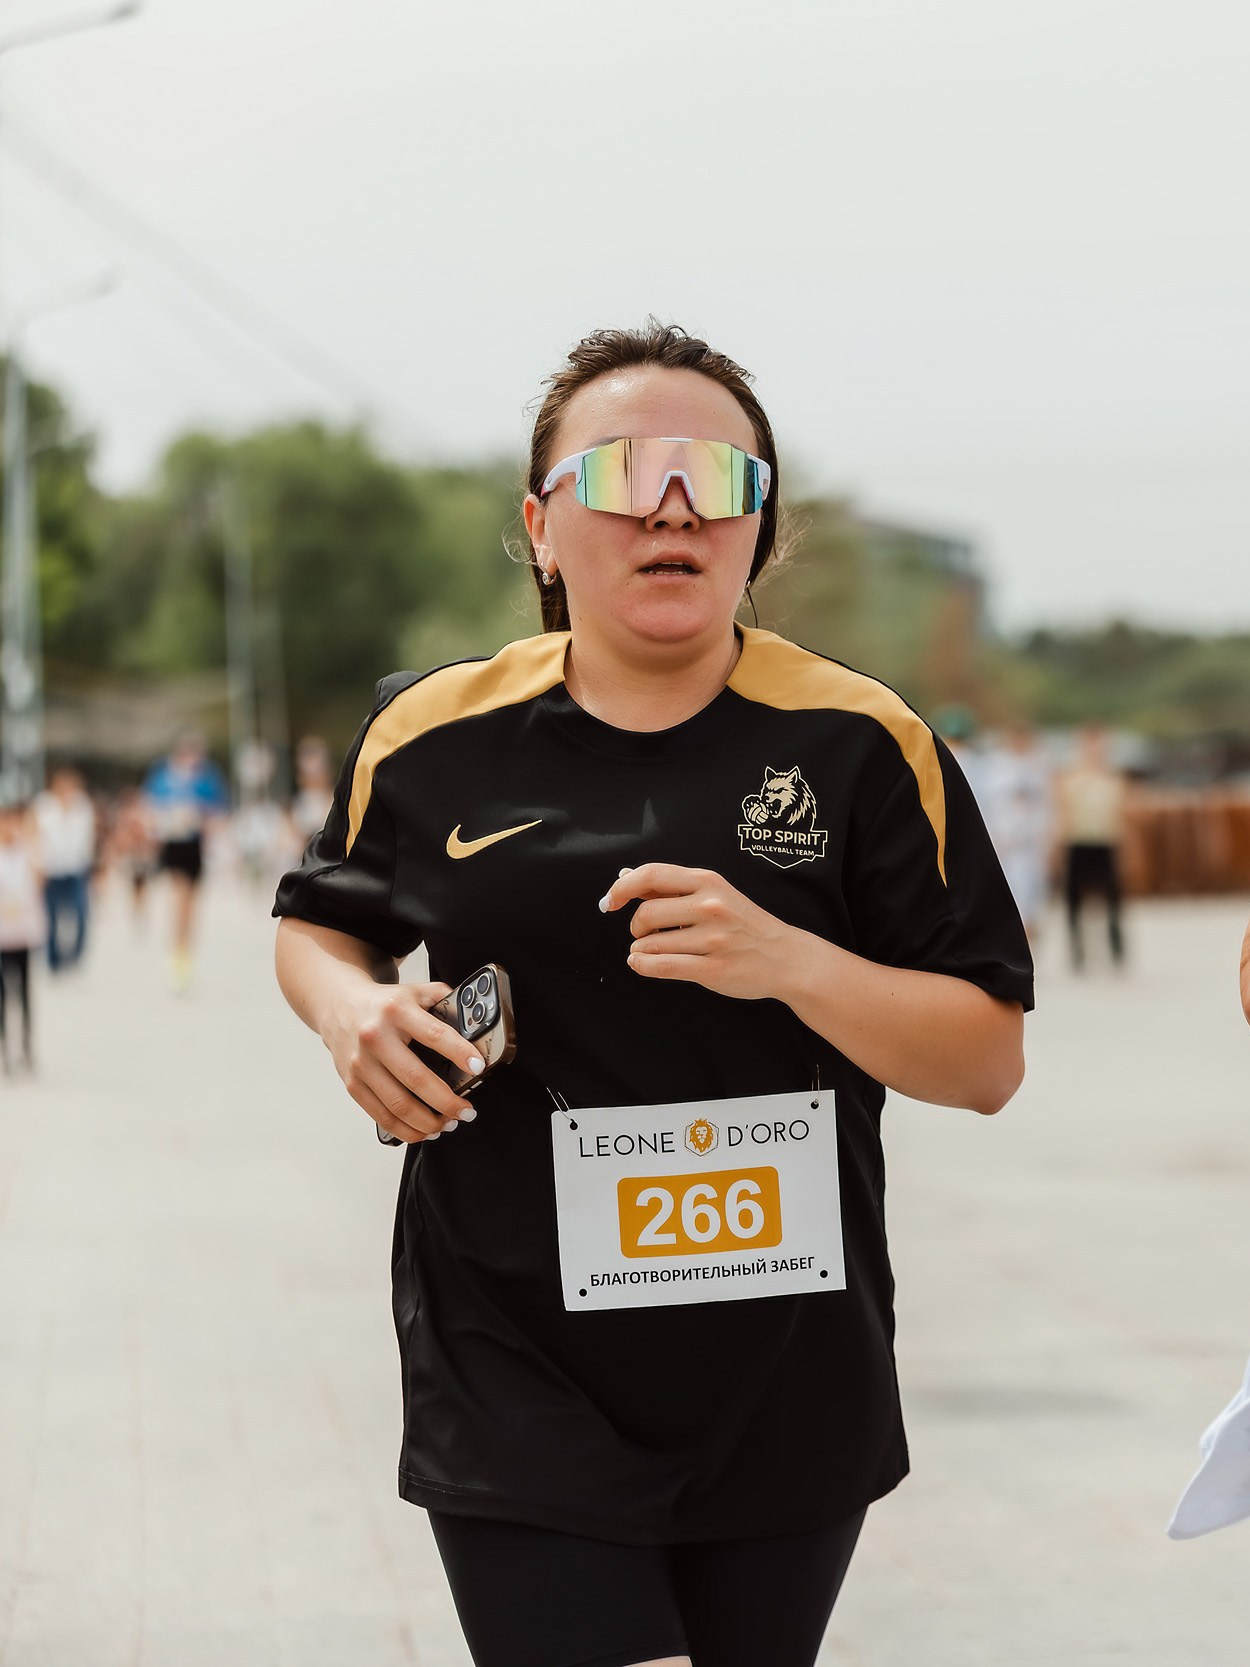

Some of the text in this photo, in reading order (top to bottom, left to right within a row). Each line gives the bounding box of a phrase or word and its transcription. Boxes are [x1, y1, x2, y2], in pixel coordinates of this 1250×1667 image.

[742, 827, 821, 846] TOP SPIRIT
[751, 844, 794, 855] VOLLEYBALL
[579, 1119, 810, 1158] LEONE D'ORO
[635, 1179, 765, 1246] 266
[590, 1256, 815, 1287] БЛАГОТВОРИТЕЛЬНЫЙ ЗАБЕГ
